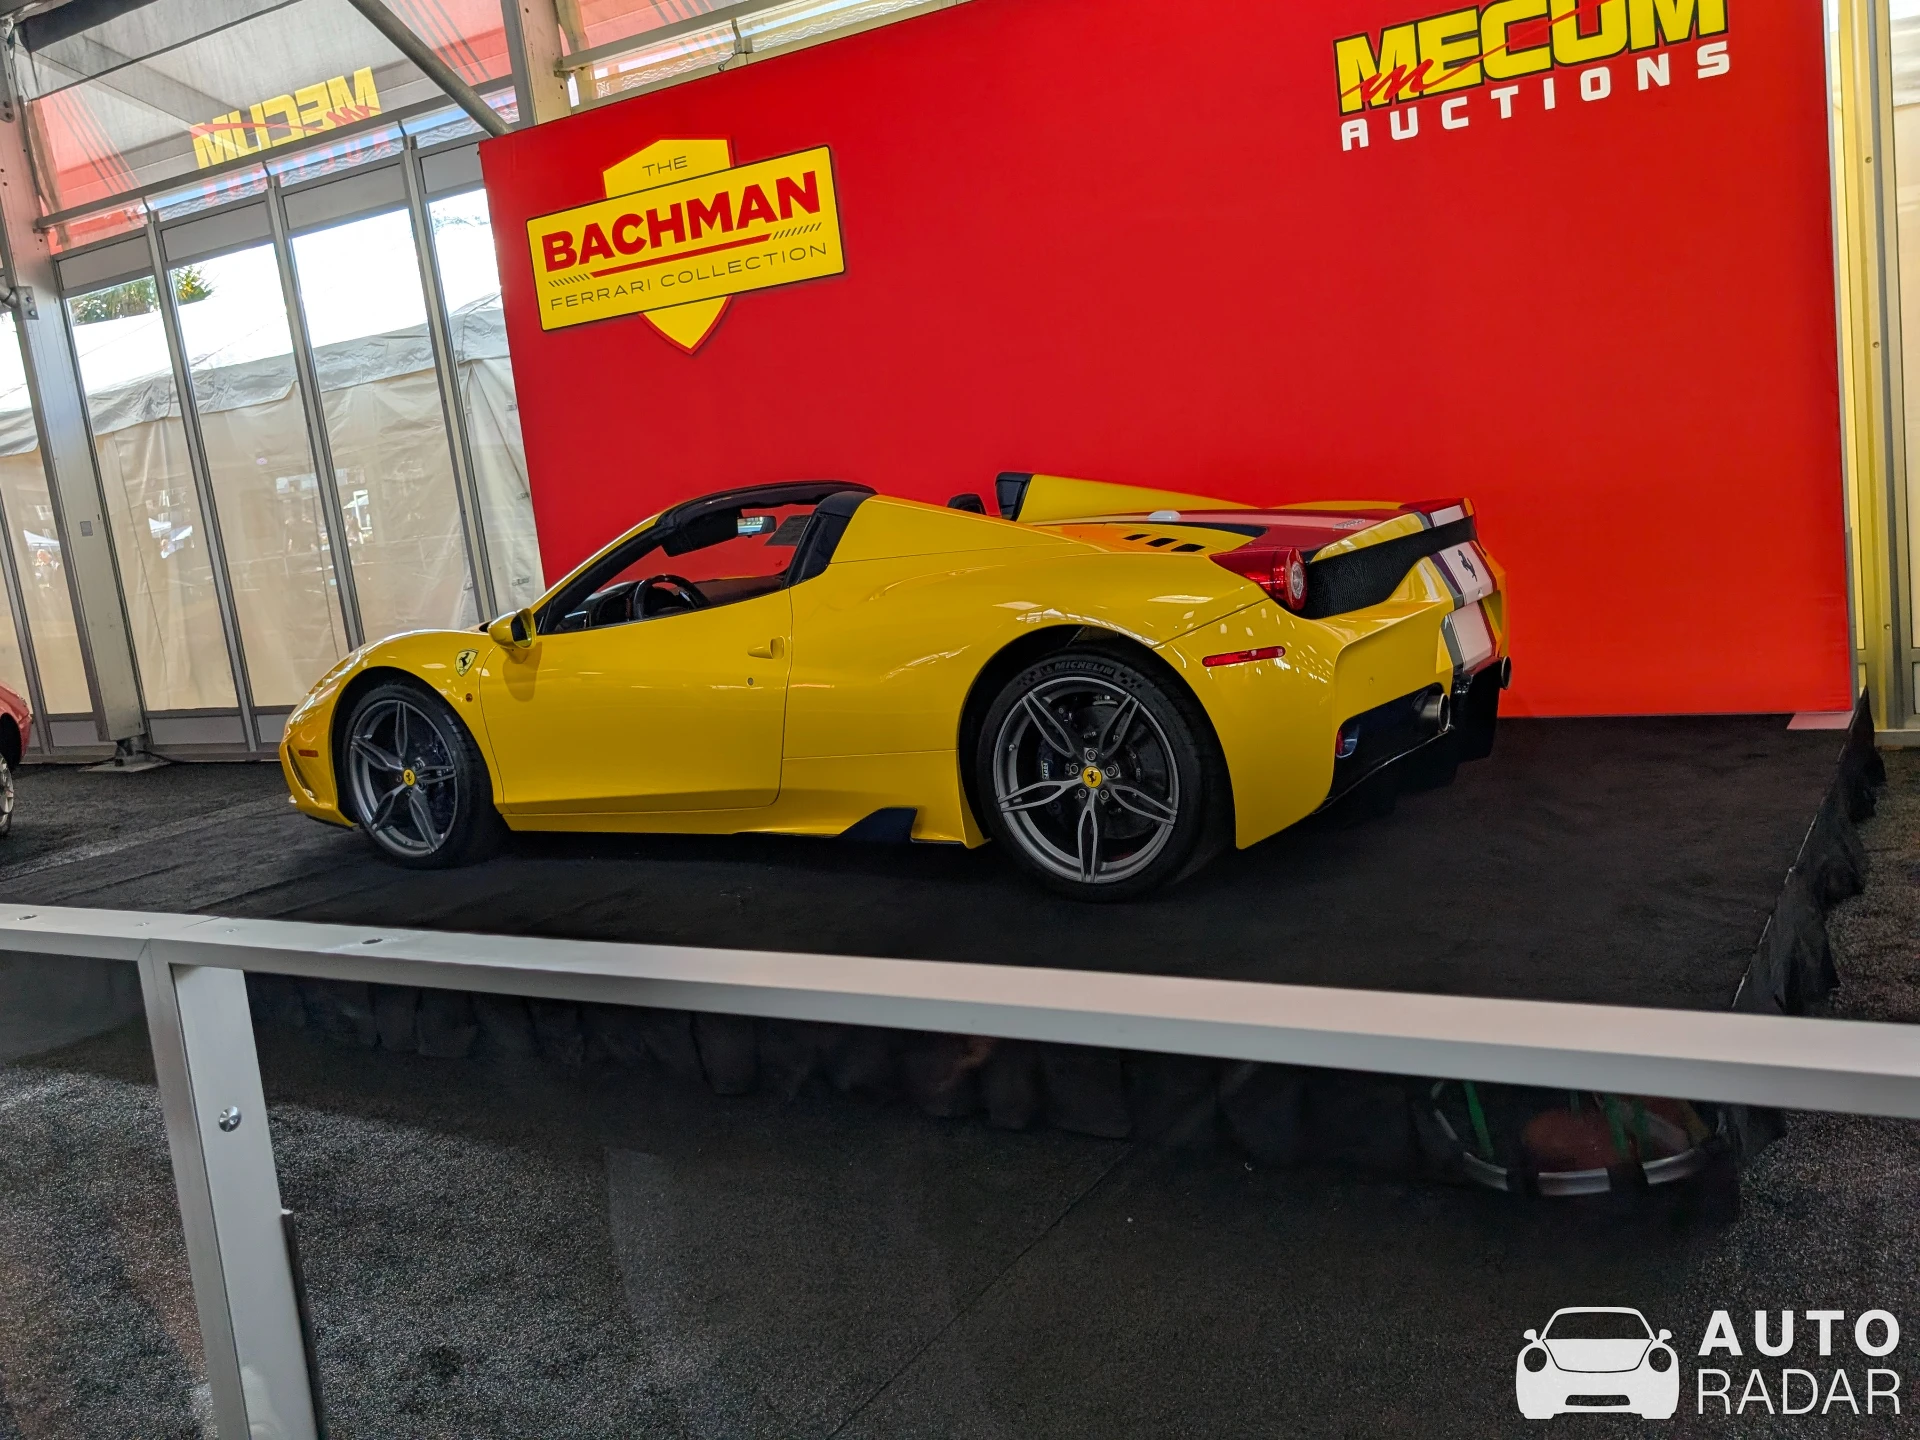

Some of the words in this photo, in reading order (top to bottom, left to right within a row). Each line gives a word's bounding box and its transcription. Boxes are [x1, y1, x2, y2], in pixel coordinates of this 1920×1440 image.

[1341, 41, 1730, 151] AUCTIONS
[642, 156, 688, 177] THE
[541, 170, 821, 273] BACHMAN
[551, 278, 652, 311] FERRARI
[660, 242, 828, 288] COLLECTION
[1054, 661, 1115, 675] MICHELIN
